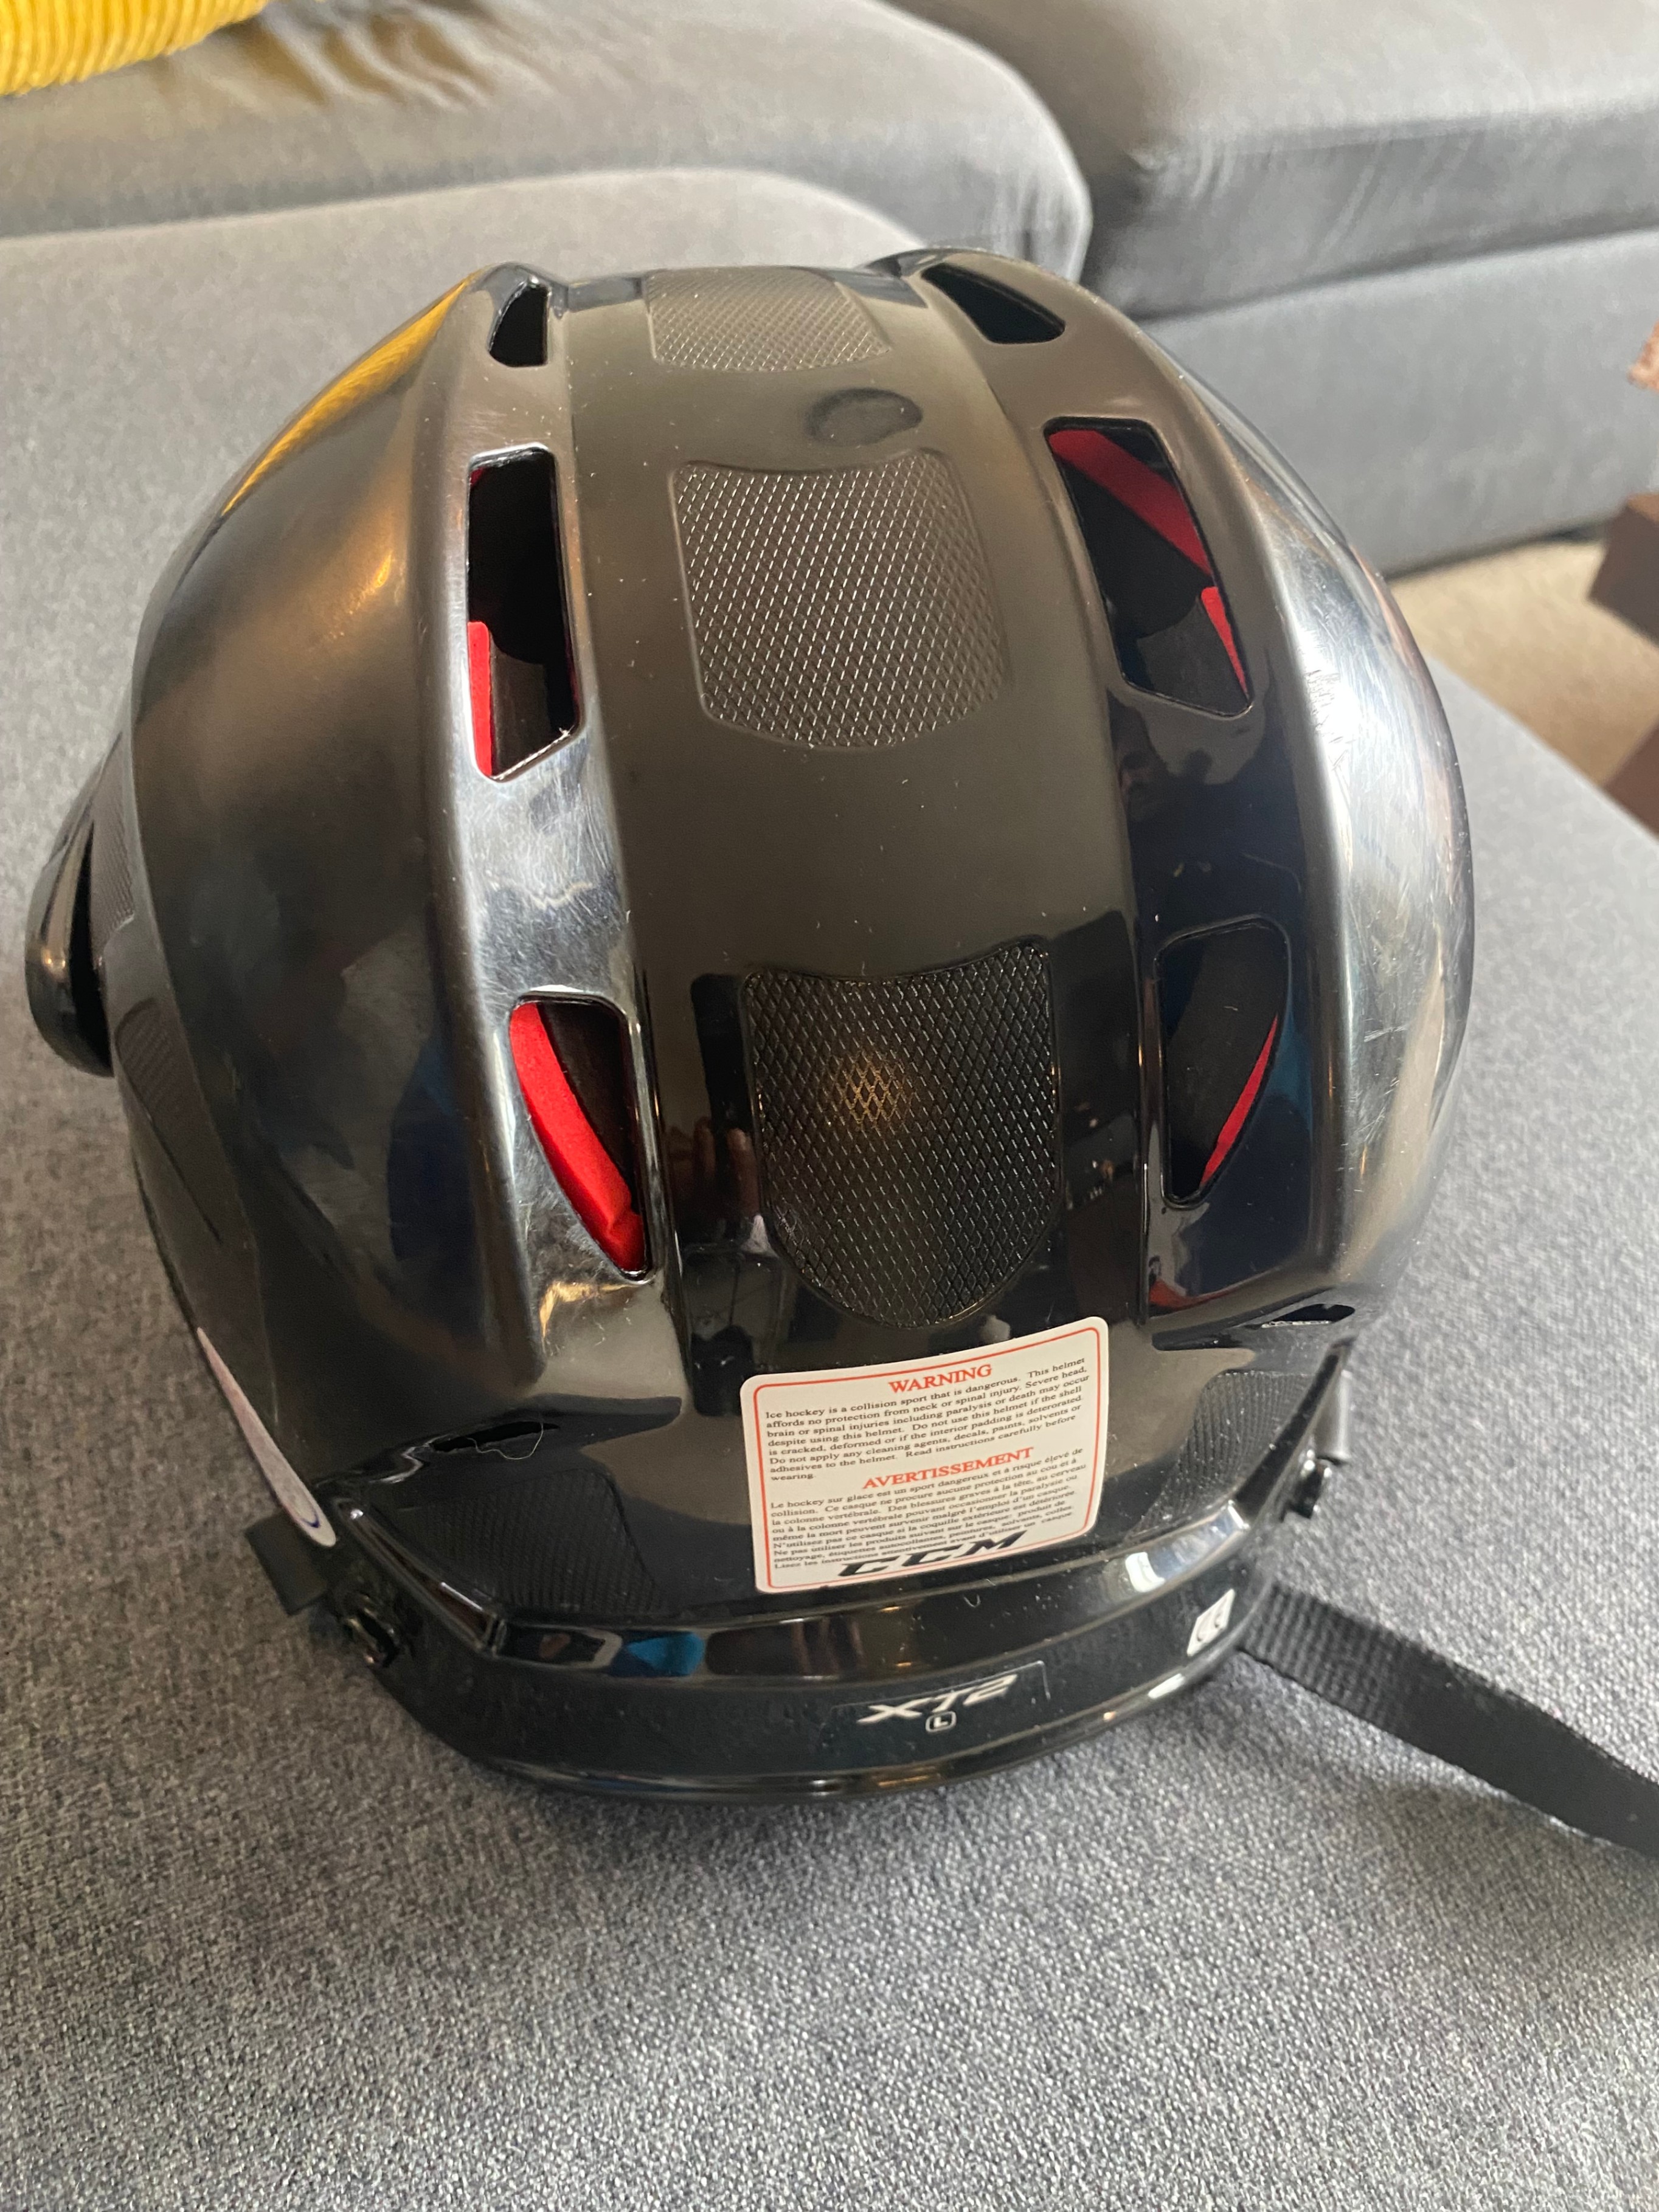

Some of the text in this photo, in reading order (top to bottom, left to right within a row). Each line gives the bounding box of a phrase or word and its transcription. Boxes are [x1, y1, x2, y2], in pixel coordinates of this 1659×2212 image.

[766, 1419, 805, 1428] affords
[825, 1412, 880, 1426] protection
[884, 1408, 909, 1417] from
[913, 1402, 937, 1412] neck
[955, 1392, 985, 1406] spinal
[1025, 1375, 1058, 1389] Severe
[785, 1409, 825, 1417] hockey
[850, 1400, 896, 1412] collision
[900, 1394, 927, 1406] sport
[930, 1389, 950, 1400] that
[1030, 1368, 1048, 1378] This
[1052, 1357, 1084, 1372] helmet
[890, 1364, 992, 1394] WARNING
[767, 1429, 795, 1437] brain
[813, 1423, 845, 1435] spinal
[849, 1419, 889, 1431] injuries
[893, 1411, 943, 1424] including
[946, 1400, 991, 1417] paralysis
[1008, 1388, 1036, 1402] death
[1039, 1384, 1059, 1394] may
[1062, 1375, 1089, 1388] occur
[767, 1437, 806, 1447] despite
[809, 1435, 839, 1443] using
[931, 1417, 947, 1427] not
[951, 1415, 968, 1423] use
[971, 1409, 989, 1419] this
[993, 1400, 1027, 1414] helmet
[1031, 1397, 1037, 1405] if
[1041, 1394, 1056, 1403] the
[1059, 1385, 1081, 1398] shell
[830, 1437, 881, 1450] deformed
[910, 1431, 926, 1439] the
[930, 1423, 968, 1436] interior
[971, 1414, 1011, 1429] padding
[770, 1464, 822, 1473] adhesives
[906, 1446, 932, 1457] Read
[935, 1436, 994, 1453] instructions
[998, 1424, 1042, 1440] carefully
[1045, 1415, 1075, 1428] before
[809, 1453, 839, 1463] apply
[865, 1444, 910, 1456] cleaning
[1028, 1408, 1068, 1423] solvents
[783, 1516, 824, 1524] colonne
[910, 1496, 955, 1509] blessures
[959, 1488, 990, 1501] graves
[1050, 1464, 1086, 1478] cerveau
[787, 1499, 824, 1508] hockey
[847, 1493, 873, 1503] glace
[909, 1482, 934, 1493] sport
[937, 1473, 989, 1487] dangereux
[1012, 1460, 1042, 1471] risque
[842, 1501, 877, 1510] casque
[895, 1491, 933, 1504] procure
[936, 1484, 971, 1496] aucune
[974, 1473, 1023, 1490] protection
[1040, 1465, 1057, 1473] cou
[1059, 1460, 1068, 1469] et
[862, 1447, 1034, 1489] AVERTISSEMENT
[808, 1521, 850, 1530] colonne
[906, 1504, 945, 1518] pouvant
[948, 1492, 1006, 1509] occasionner
[1020, 1479, 1062, 1495] paralysie
[838, 1530, 1027, 1576] CCM
